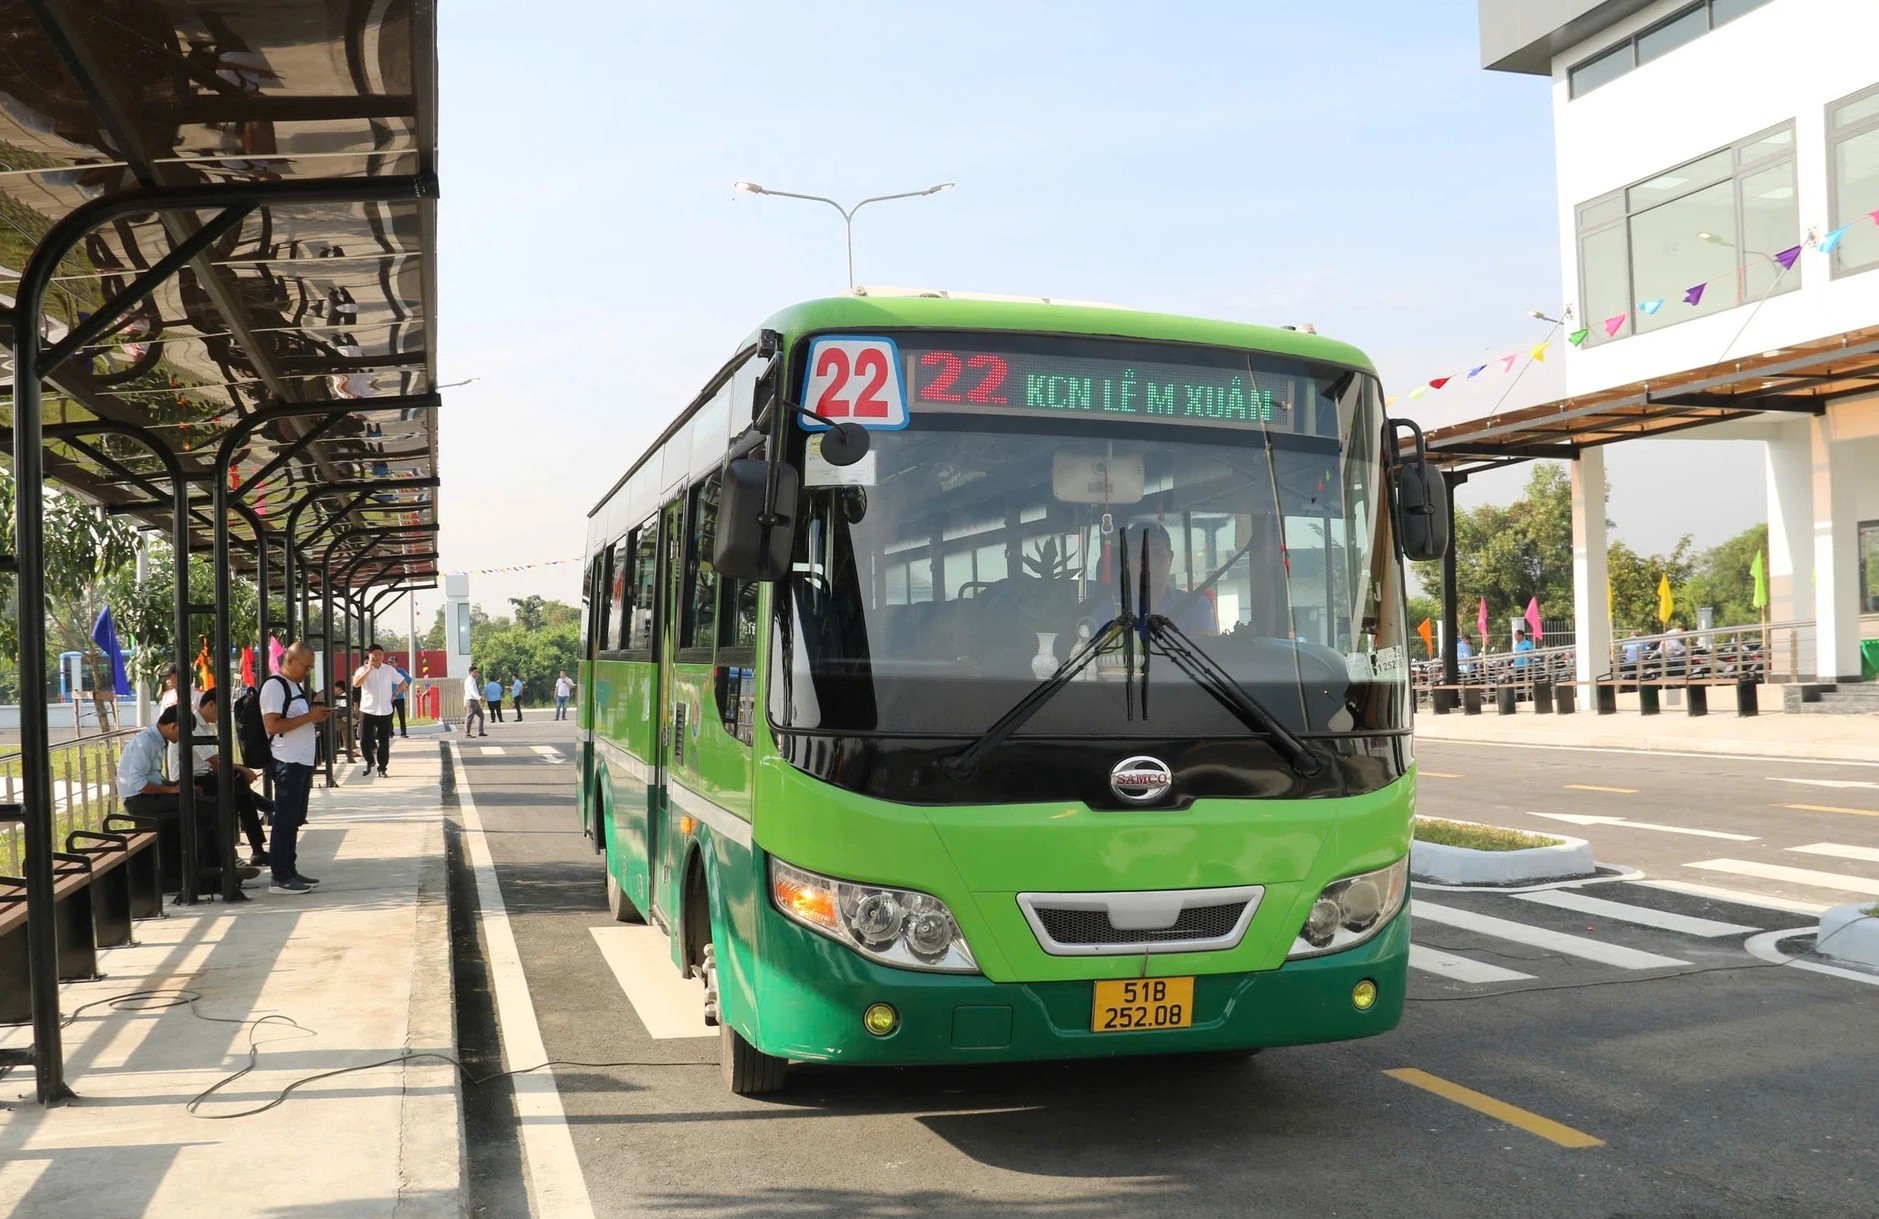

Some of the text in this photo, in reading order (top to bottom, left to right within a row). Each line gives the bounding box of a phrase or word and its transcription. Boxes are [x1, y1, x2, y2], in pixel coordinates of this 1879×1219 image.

[815, 347, 889, 418] 22
[920, 351, 1272, 422] 22 KCN LÊ M XUÂN
[1116, 773, 1168, 785] SAMCO
[1123, 981, 1167, 1003] 51B
[1104, 1004, 1183, 1029] 252.08
